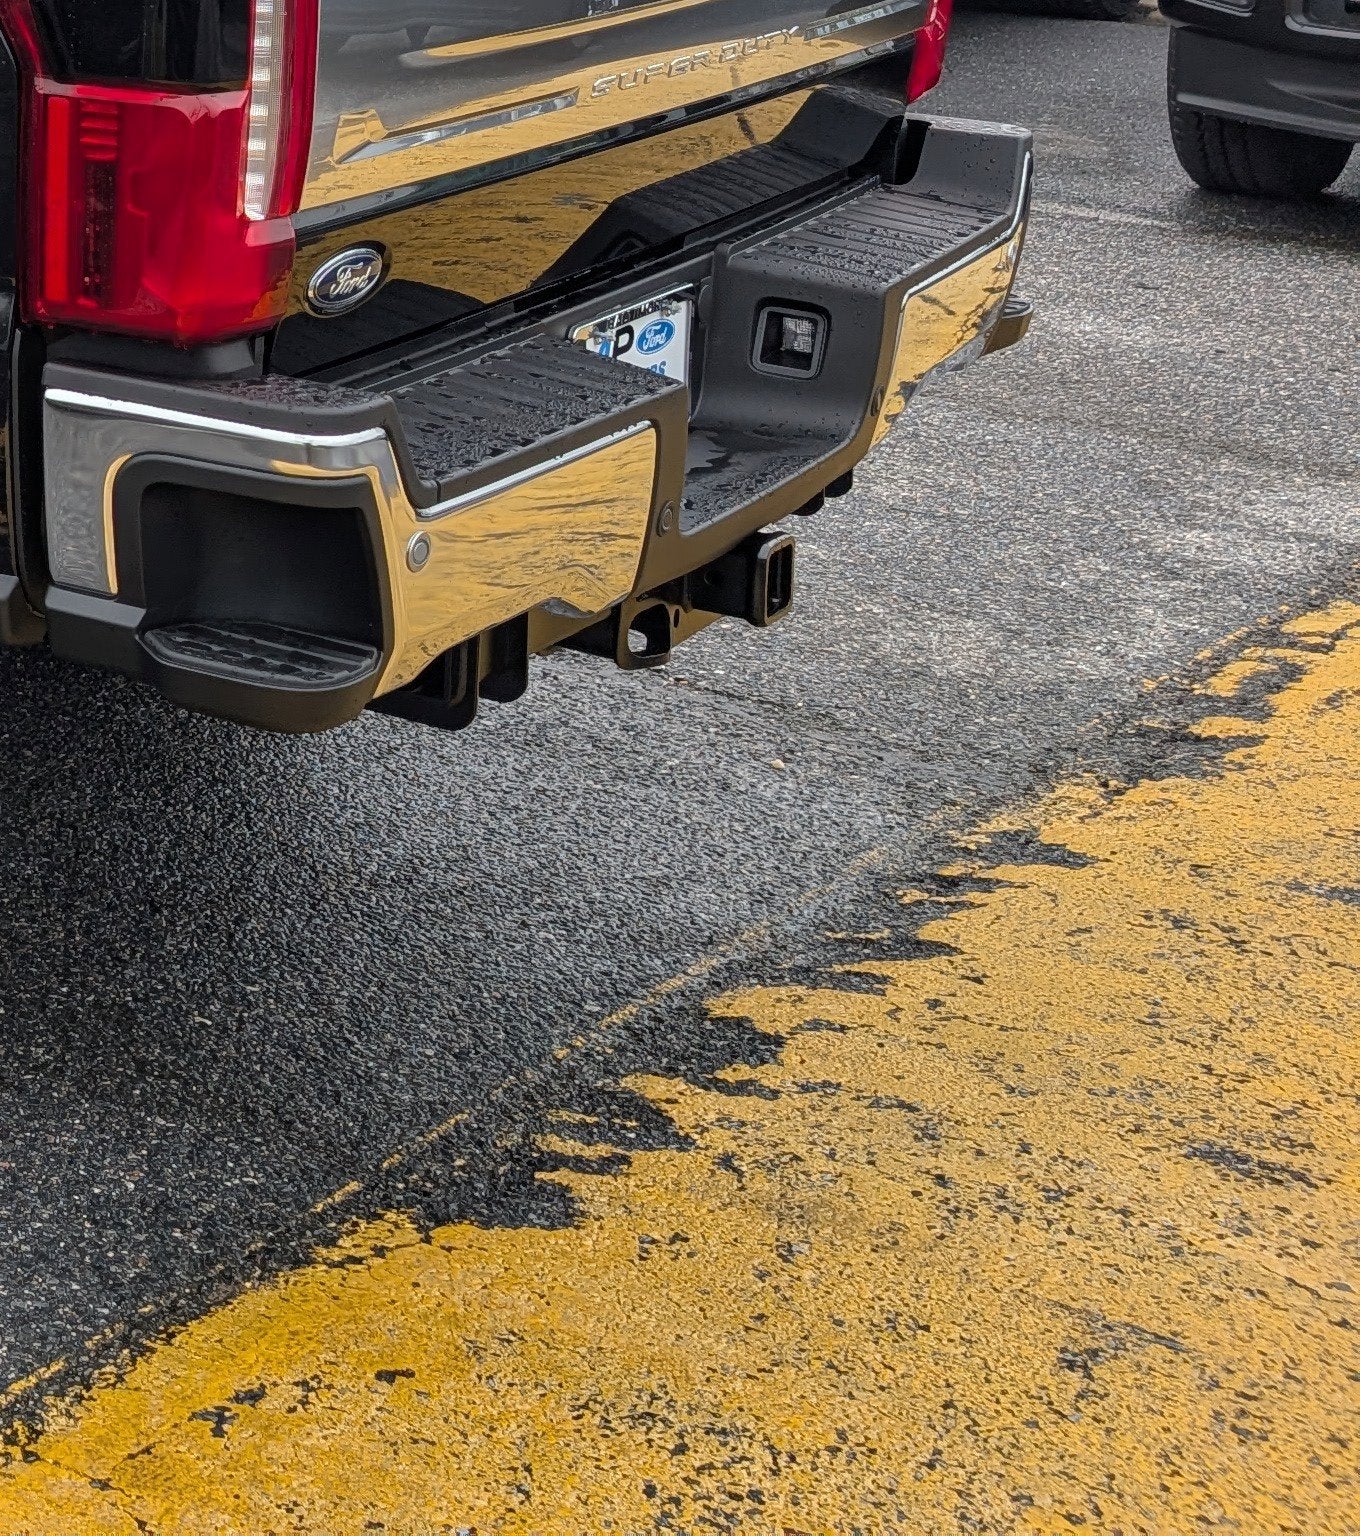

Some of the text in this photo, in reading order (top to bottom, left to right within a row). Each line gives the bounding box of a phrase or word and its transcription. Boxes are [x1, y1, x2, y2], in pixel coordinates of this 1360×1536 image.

[591, 25, 800, 97] SUPER DUTY
[329, 261, 372, 299] Ford
[642, 323, 669, 352] Ford
